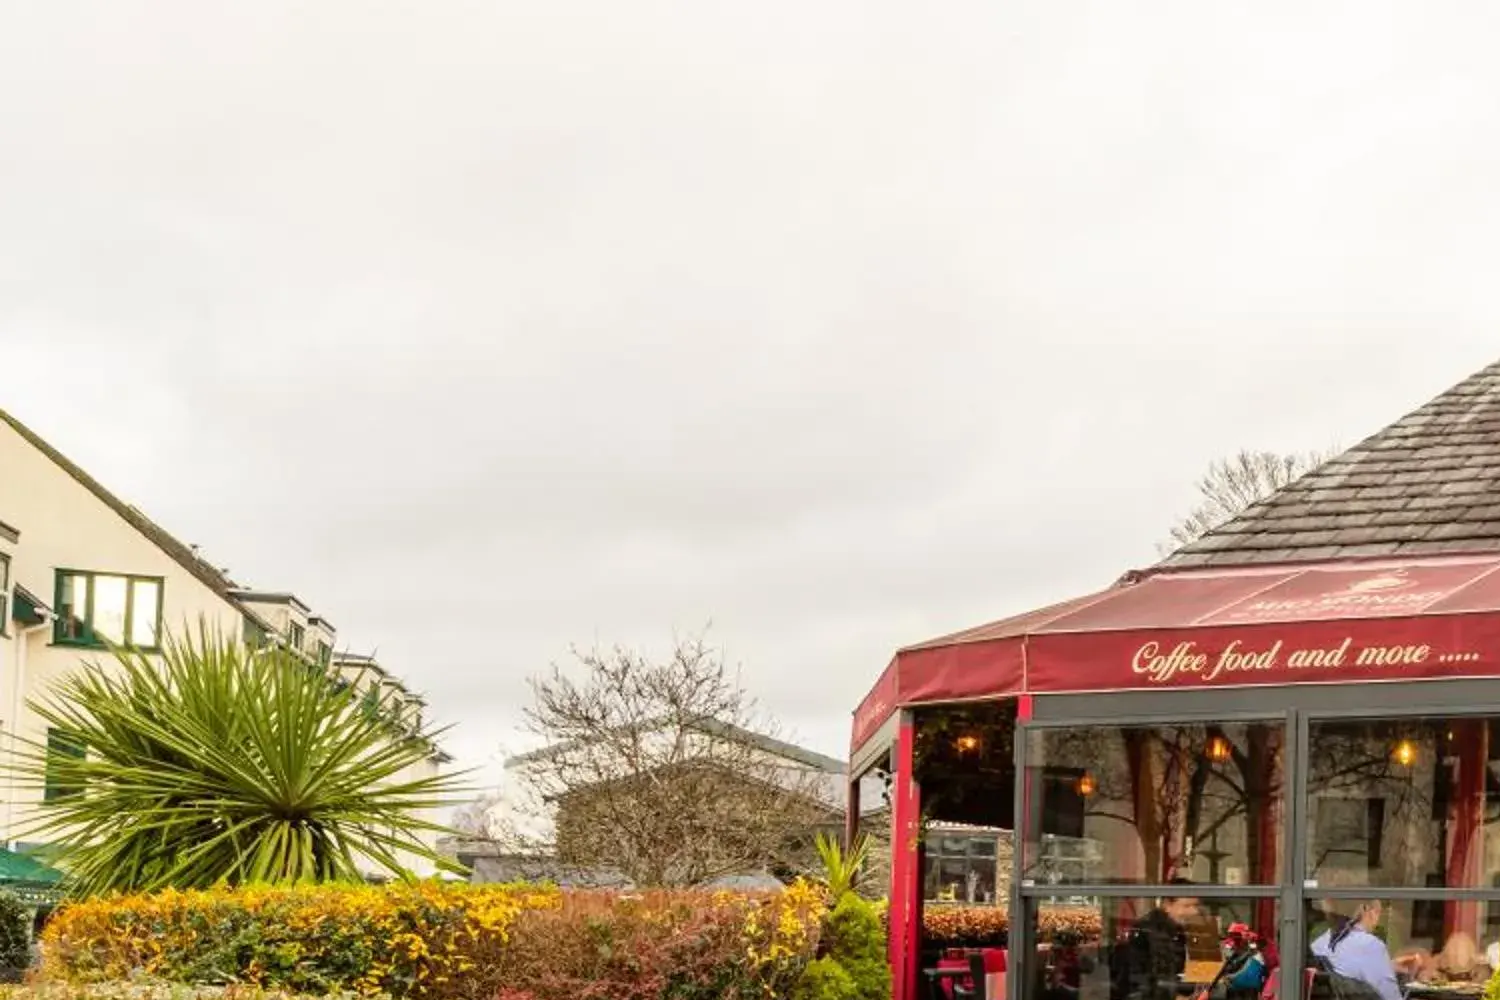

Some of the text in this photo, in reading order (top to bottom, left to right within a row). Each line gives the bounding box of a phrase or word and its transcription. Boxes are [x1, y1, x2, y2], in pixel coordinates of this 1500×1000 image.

[1131, 641, 1206, 682] Coffee
[1203, 638, 1283, 680] food
[1286, 638, 1352, 668] and
[1357, 643, 1430, 668] more
